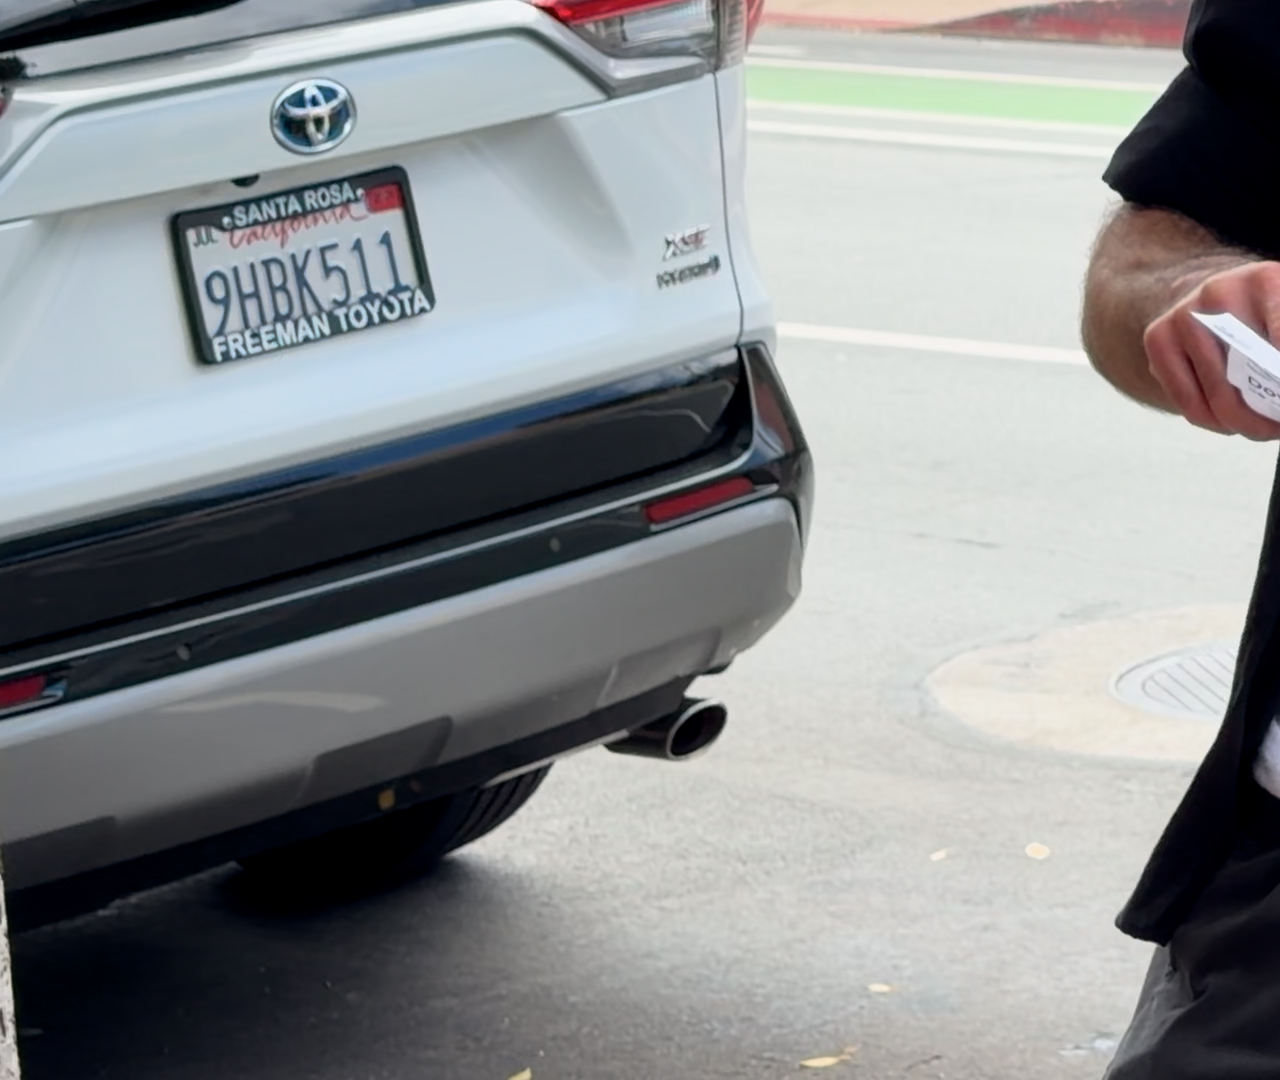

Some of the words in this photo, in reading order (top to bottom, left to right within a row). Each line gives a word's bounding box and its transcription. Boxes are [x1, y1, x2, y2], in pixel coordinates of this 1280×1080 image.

[232, 194, 302, 227] SANTA
[304, 181, 355, 212] ROSA
[204, 230, 412, 339] 9HBK511
[212, 312, 331, 364] FREEMAN
[334, 287, 432, 333] TOYOTA
